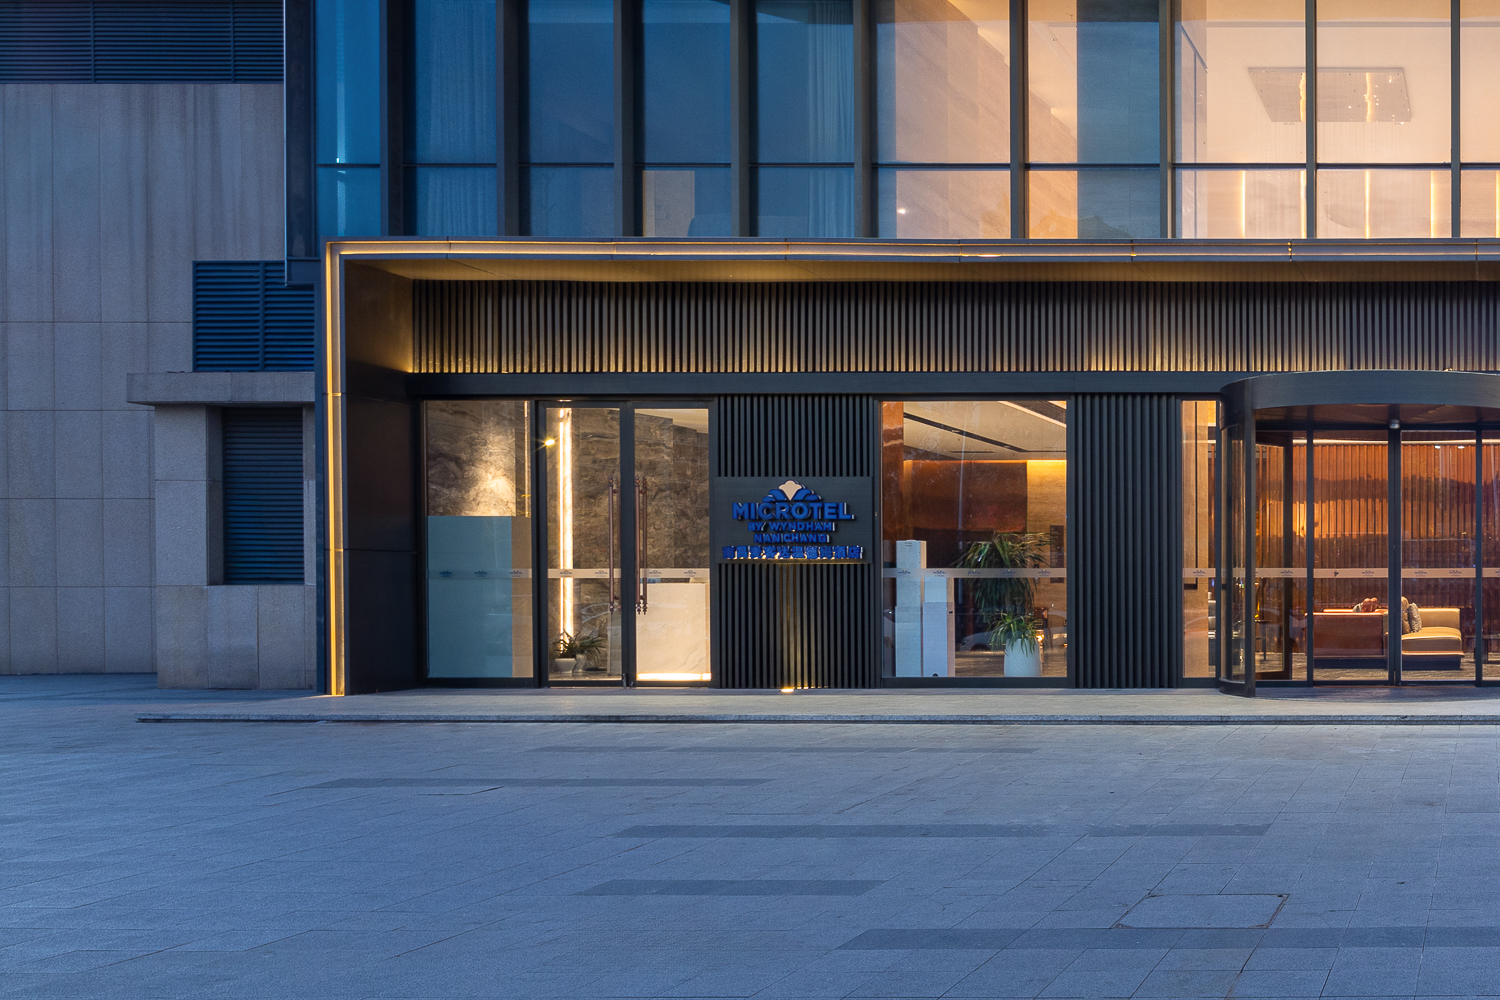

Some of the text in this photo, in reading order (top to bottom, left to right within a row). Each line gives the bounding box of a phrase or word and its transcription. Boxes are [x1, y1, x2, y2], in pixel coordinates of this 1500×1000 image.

[732, 502, 853, 520] MICROTEL
[748, 522, 834, 532] BY WYNDHAM
[753, 533, 829, 543] NANCHANG
